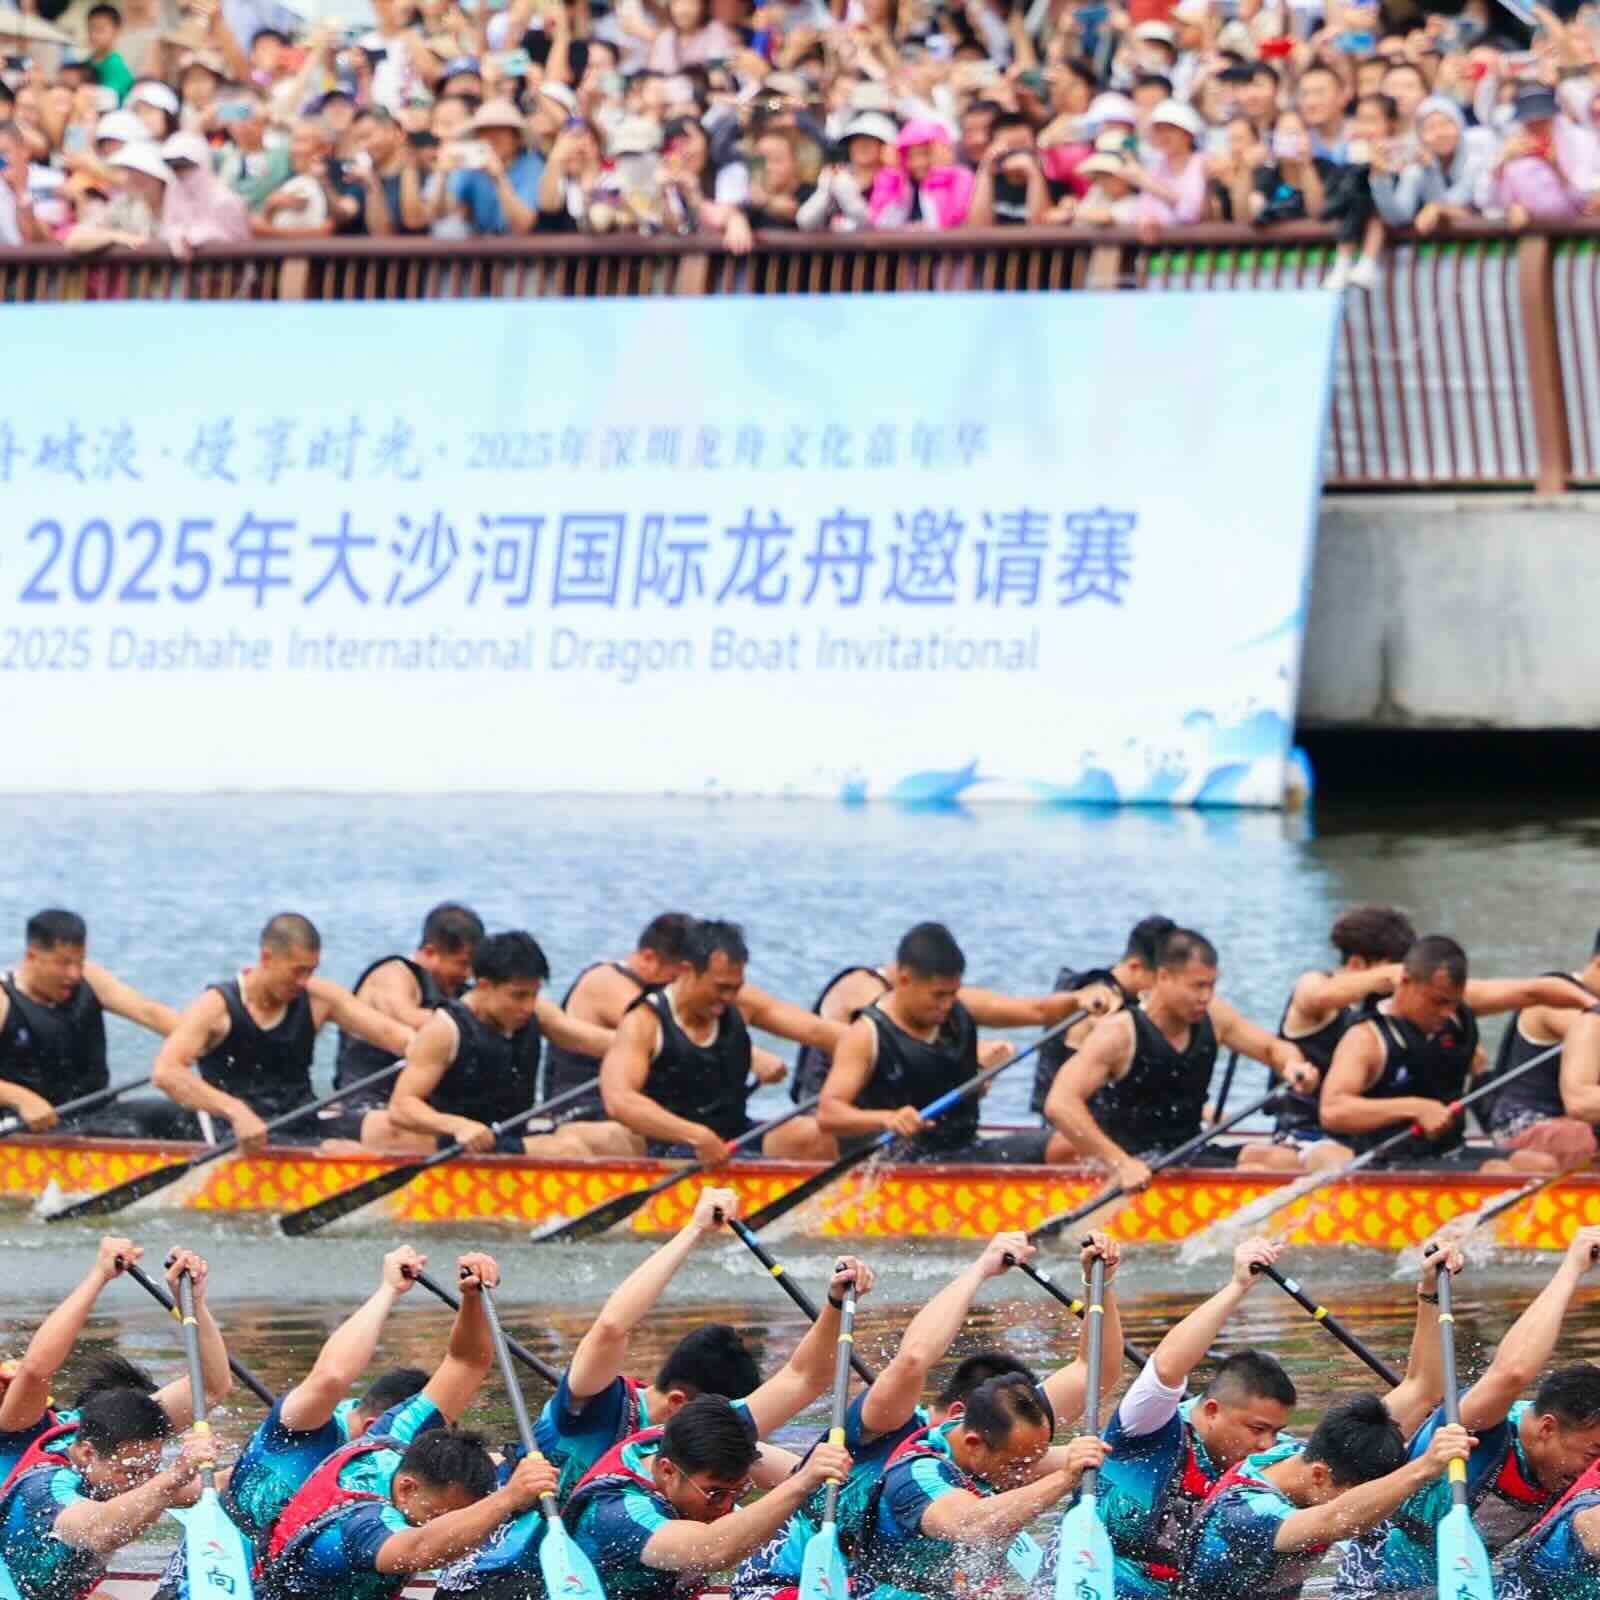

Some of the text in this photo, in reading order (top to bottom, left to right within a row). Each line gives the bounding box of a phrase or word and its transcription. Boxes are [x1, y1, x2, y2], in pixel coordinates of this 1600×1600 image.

[106, 627, 274, 673] Dashahe
[287, 627, 534, 673] International
[549, 627, 695, 685] Dragon
[710, 627, 800, 673] Boat
[816, 627, 1041, 673] Invitational
